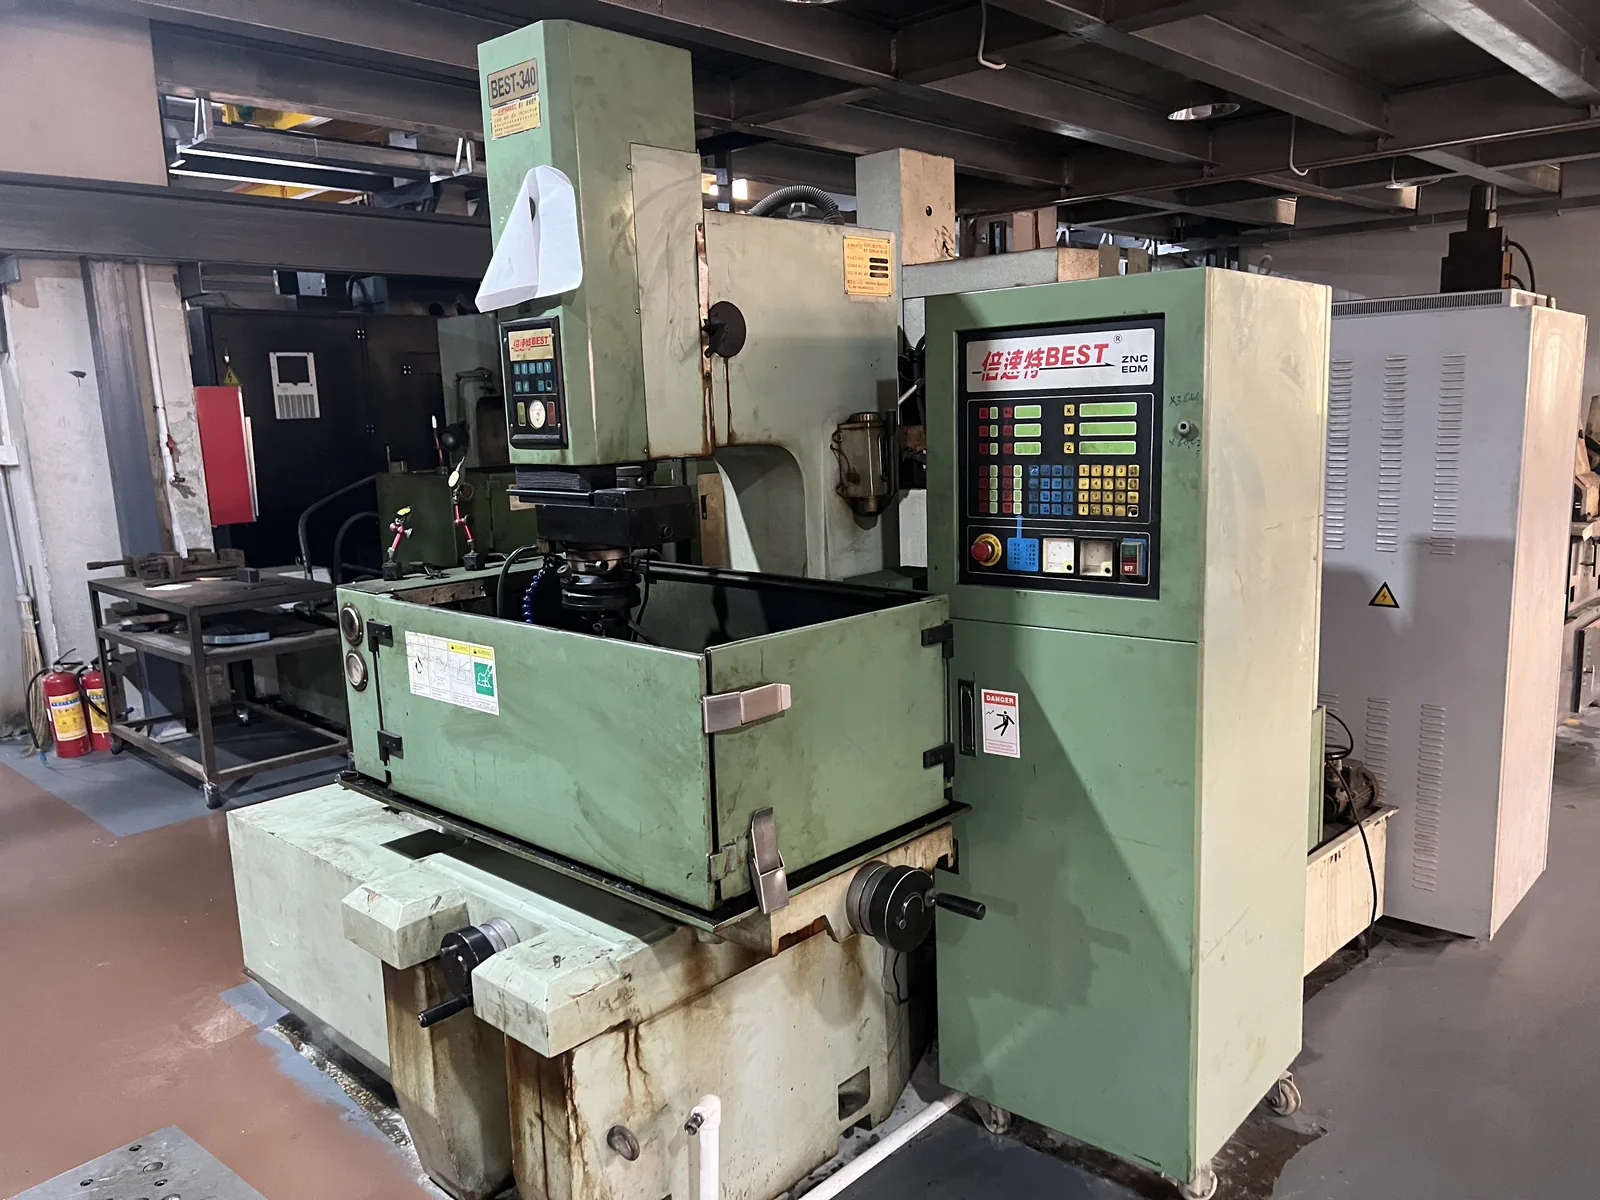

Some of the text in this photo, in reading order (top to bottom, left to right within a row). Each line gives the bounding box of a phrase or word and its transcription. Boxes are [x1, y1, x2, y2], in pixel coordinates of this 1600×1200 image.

[491, 67, 536, 99] BEST-340
[1121, 354, 1149, 364] ZNC
[1121, 364, 1149, 374] EDM
[986, 695, 1014, 704] DANGER
